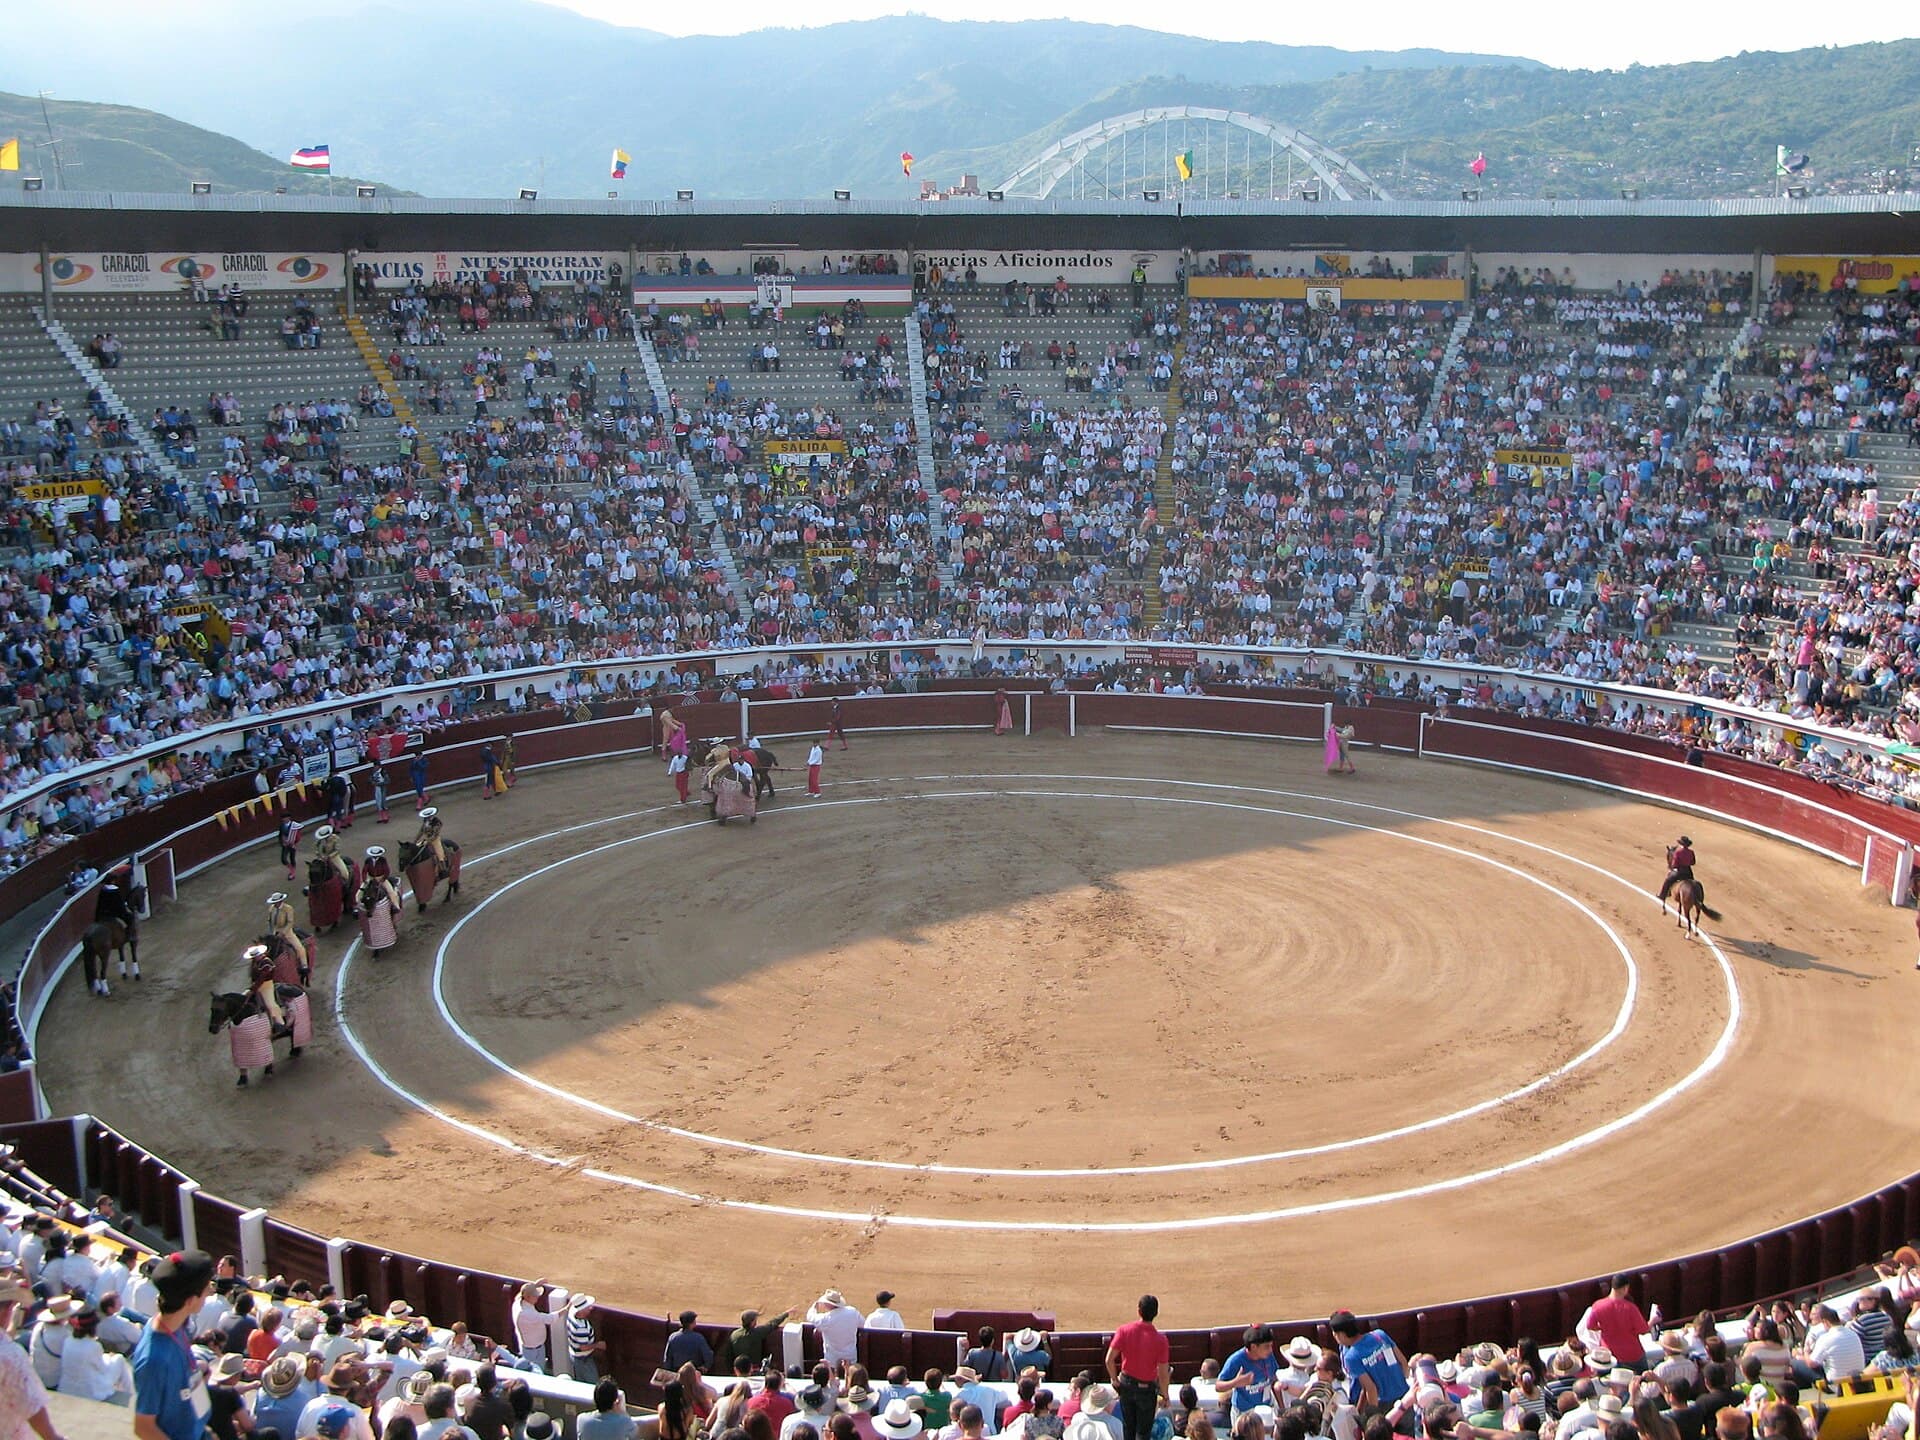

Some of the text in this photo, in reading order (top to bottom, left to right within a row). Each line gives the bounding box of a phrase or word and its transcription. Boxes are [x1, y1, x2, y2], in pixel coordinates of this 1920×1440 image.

[102, 255, 151, 272] CARACOL
[222, 254, 268, 272] CARACOL
[460, 255, 603, 268] NUESTRO GRAN
[994, 252, 1114, 268] Aficionados
[346, 261, 424, 278] RACIAS
[781, 442, 829, 452] SALIDA
[1512, 453, 1561, 466] SALIDA
[32, 484, 85, 499] SALIDA
[812, 549, 849, 557] SALIDA
[1459, 562, 1490, 573] SALID
[173, 604, 207, 617] ALIDA
